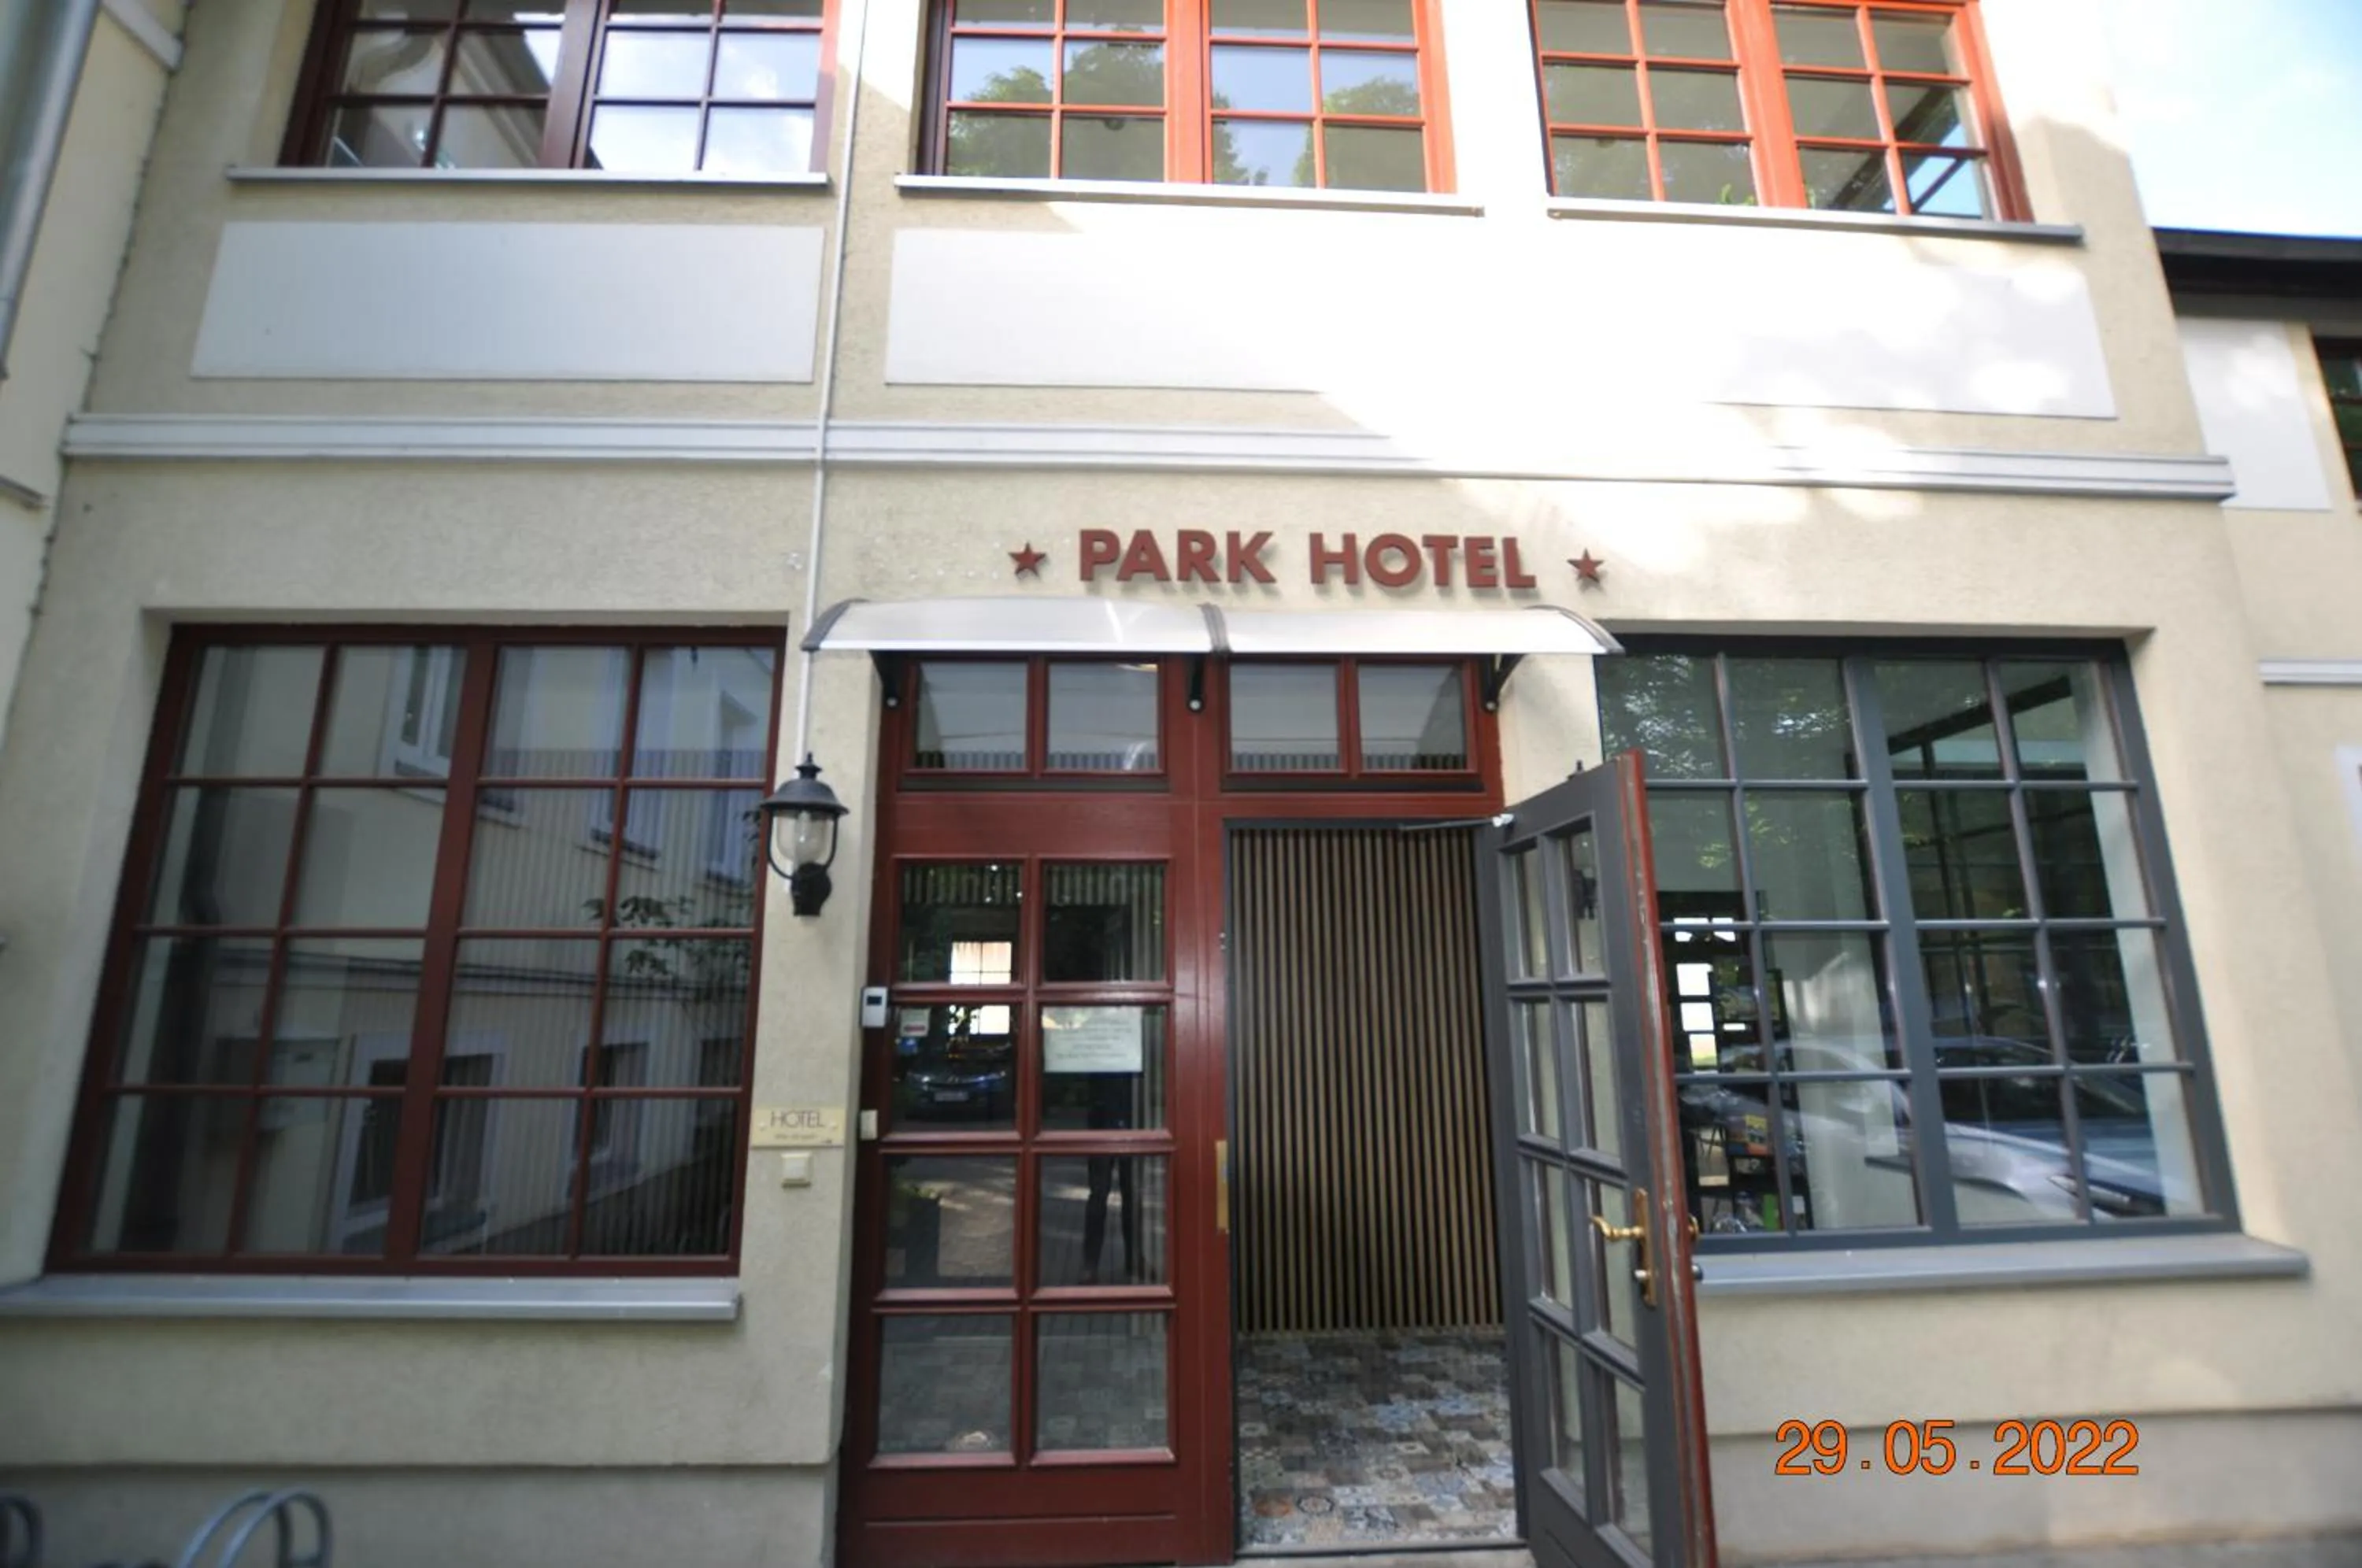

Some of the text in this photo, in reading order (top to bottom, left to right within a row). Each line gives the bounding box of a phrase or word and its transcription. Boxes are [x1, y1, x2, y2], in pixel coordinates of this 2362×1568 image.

[1079, 529, 1536, 589] PARK HOTEL
[771, 1111, 825, 1128] HOTEL
